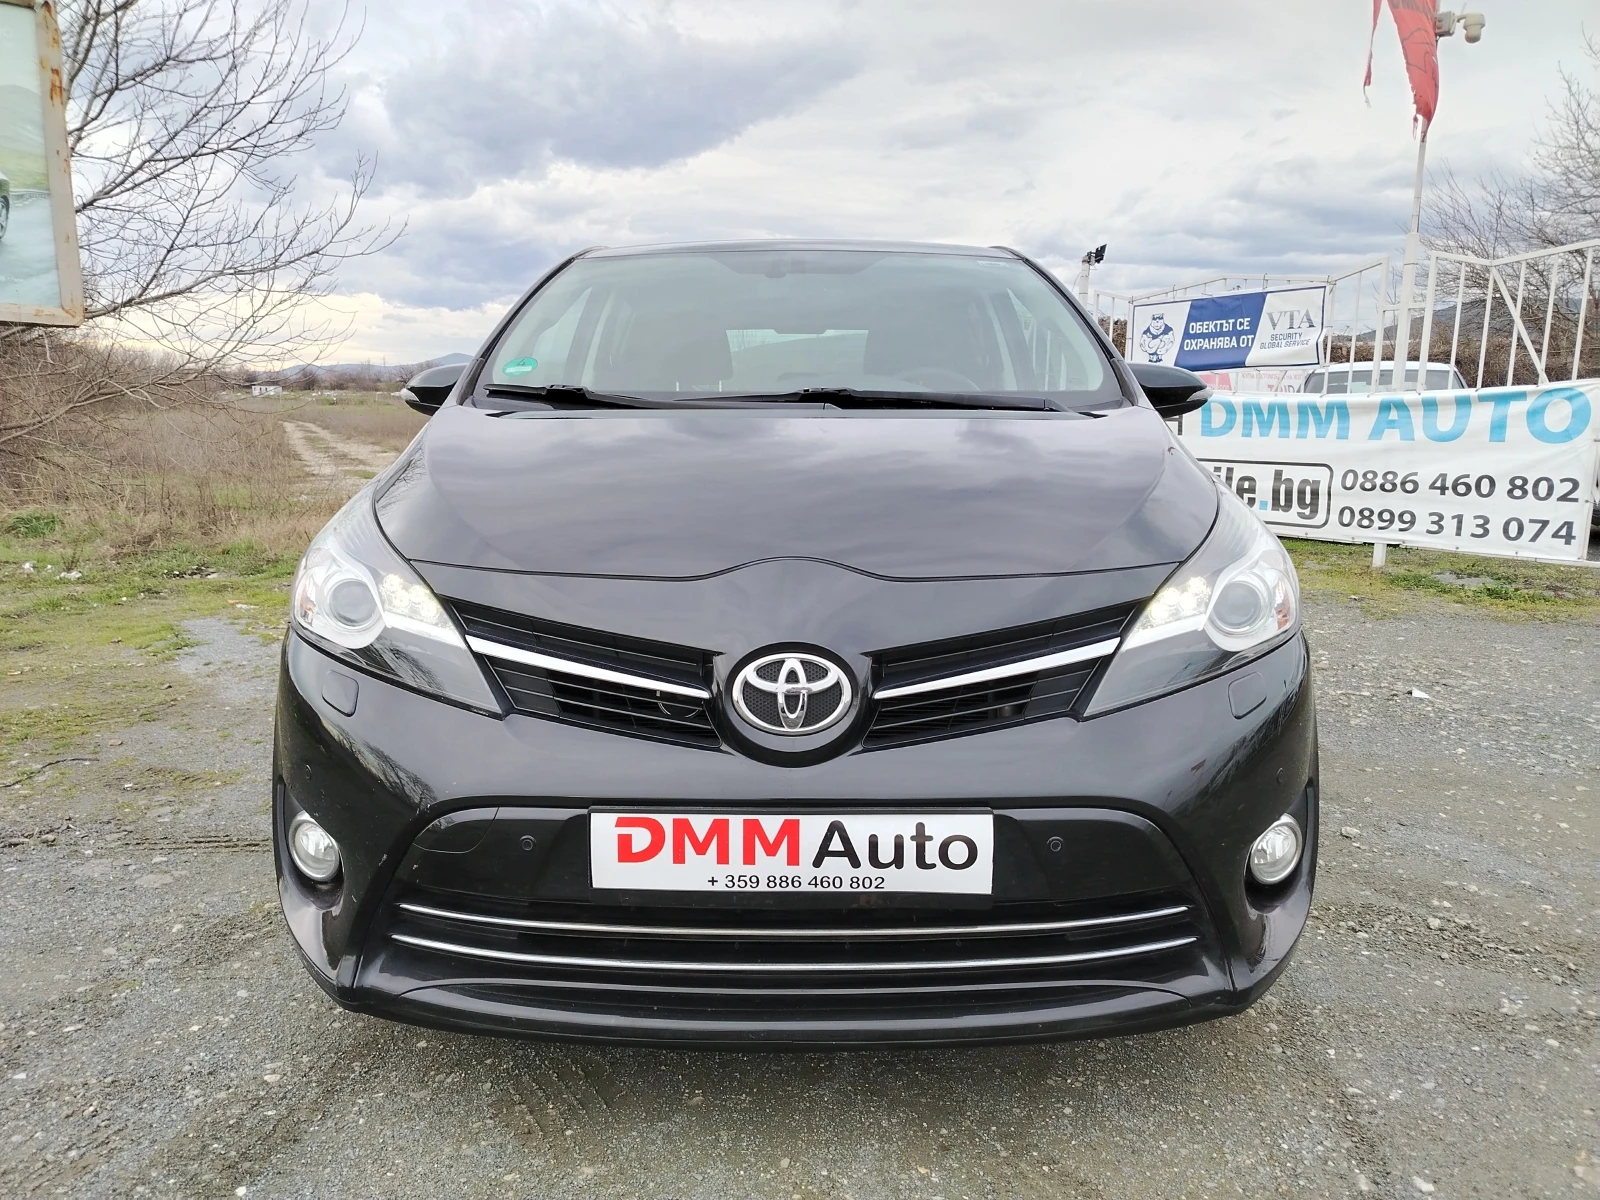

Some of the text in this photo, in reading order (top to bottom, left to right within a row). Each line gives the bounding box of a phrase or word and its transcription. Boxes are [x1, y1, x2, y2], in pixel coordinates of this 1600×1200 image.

[1189, 317, 1251, 334] ОБЕКТЪТ СЕ
[1266, 309, 1316, 330] VTA
[1183, 334, 1255, 351] ОХРАНЯВА ОТ
[1260, 338, 1311, 350] GLOBAL SERVICE
[1270, 332, 1303, 342] SECURITY
[1200, 397, 1350, 440] DMM
[1367, 387, 1592, 445] AUTO
[1341, 469, 1580, 503] 0886 460 802
[1338, 505, 1577, 546] 0899 313 074
[614, 816, 979, 871] DMM Auto
[724, 875, 760, 889] 359
[766, 875, 802, 889] 886
[808, 876, 843, 889] 460
[850, 876, 886, 890] 802
